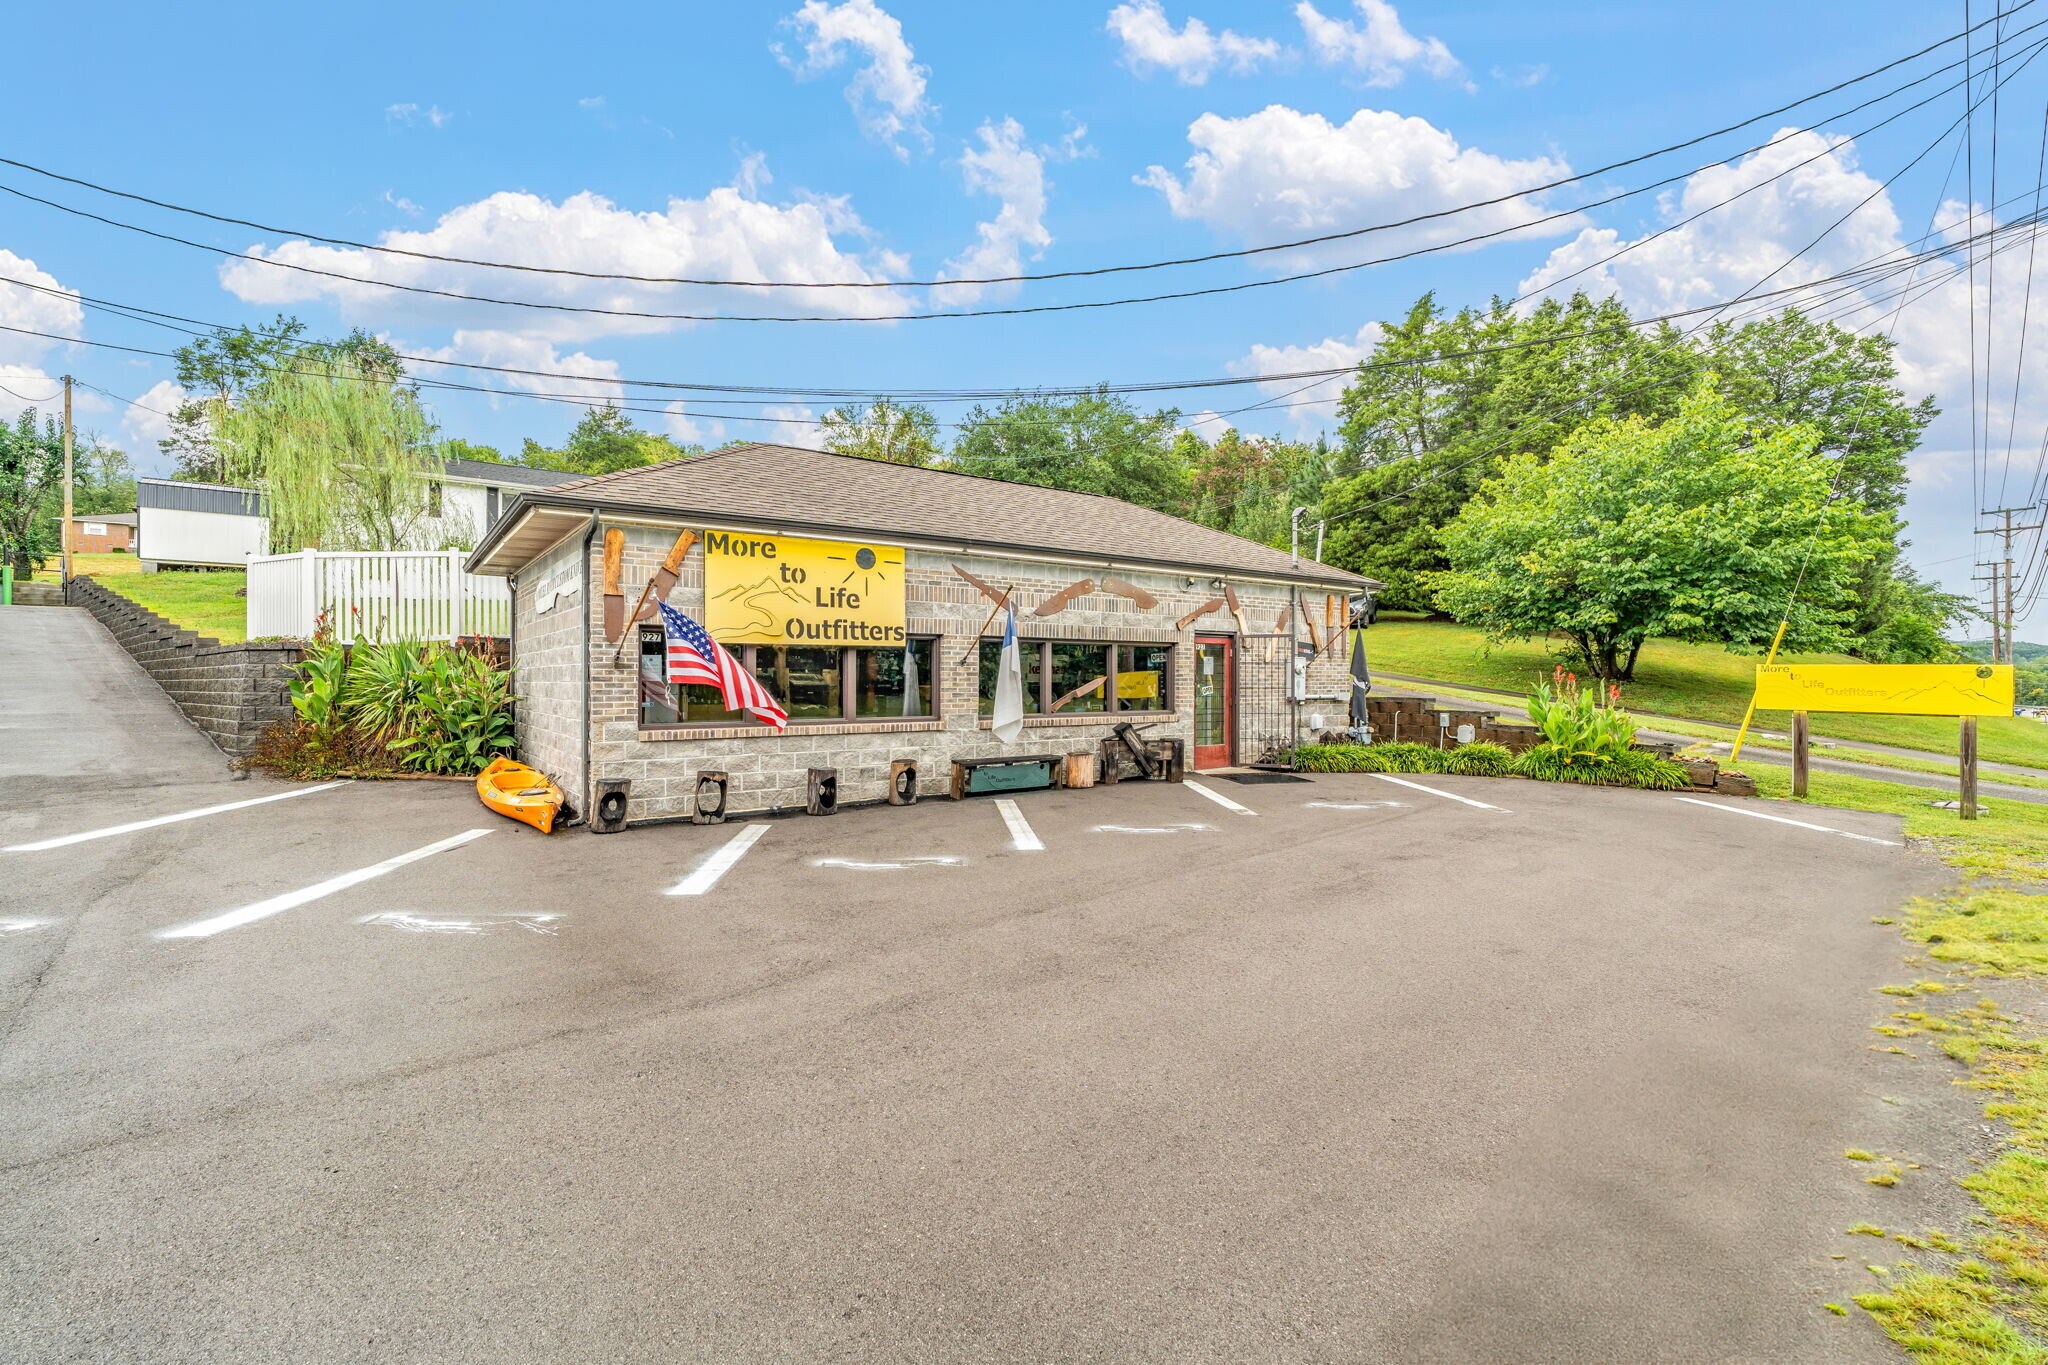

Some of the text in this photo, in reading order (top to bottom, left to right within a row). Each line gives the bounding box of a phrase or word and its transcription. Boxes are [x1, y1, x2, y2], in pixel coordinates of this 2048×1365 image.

[707, 533, 776, 558] More
[780, 563, 806, 583] to
[816, 587, 860, 609] Life
[786, 618, 905, 641] Outfitters
[1151, 654, 1167, 662] OPEN
[1760, 665, 1790, 673] More
[1802, 680, 1825, 688] Life
[1824, 688, 1888, 697] Outfitters
